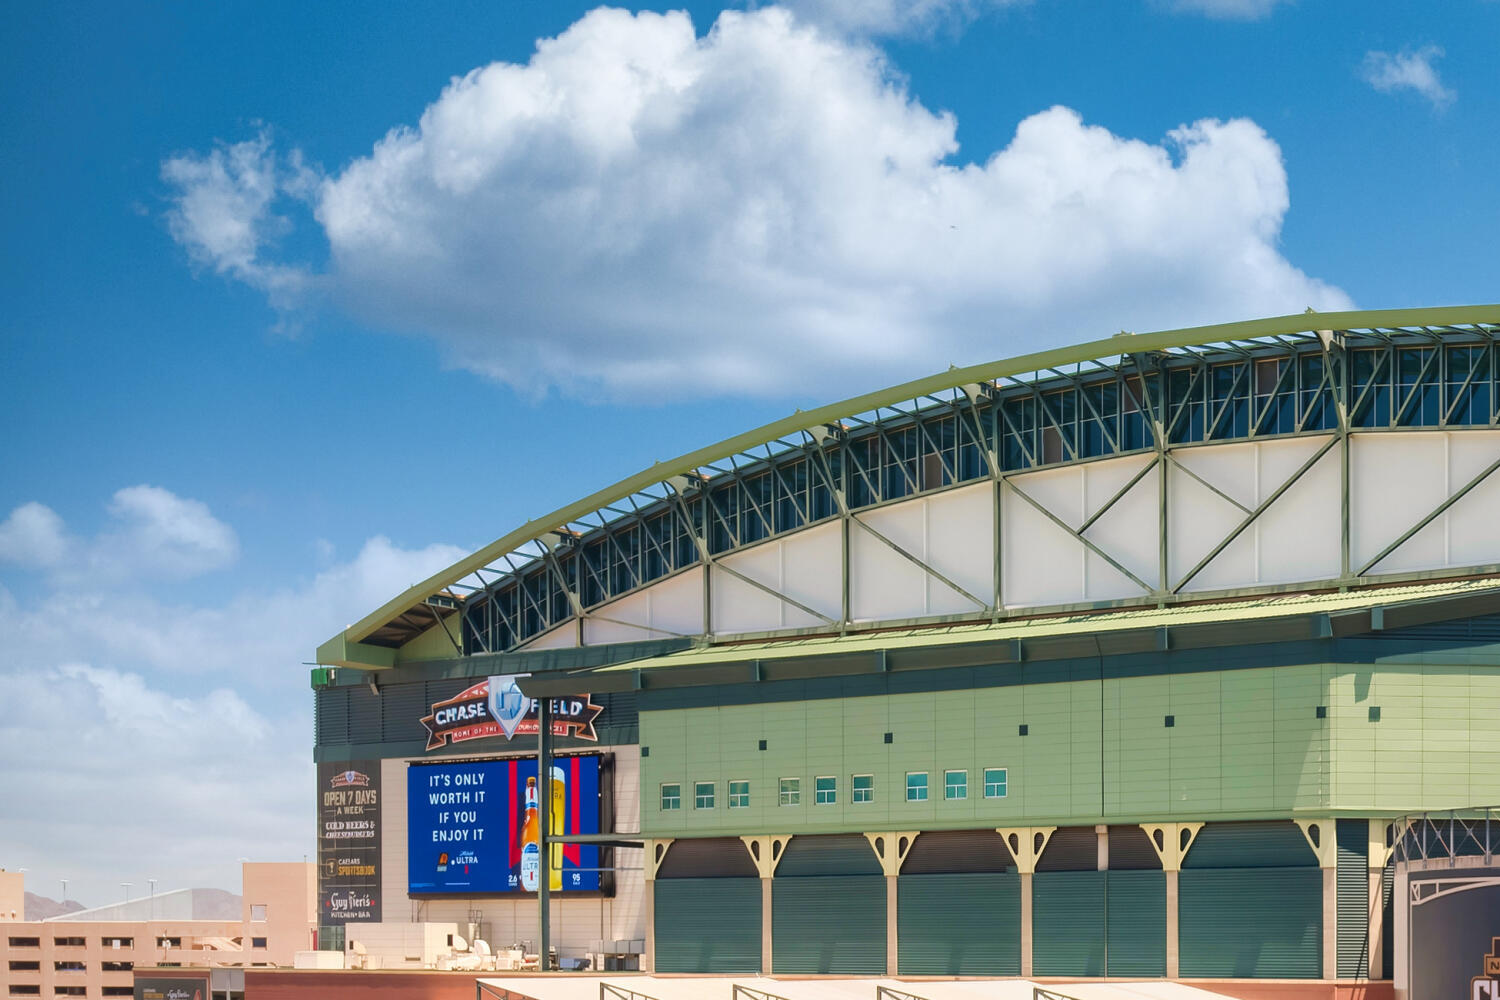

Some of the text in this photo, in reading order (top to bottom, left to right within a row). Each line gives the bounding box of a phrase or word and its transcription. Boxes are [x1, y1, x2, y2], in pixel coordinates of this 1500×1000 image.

[435, 699, 583, 725] CHASE FELD
[454, 730, 471, 739] HOME
[486, 726, 497, 734] THE
[430, 773, 485, 787] IT'S ONLY
[324, 790, 377, 806] OPEN 7 DAYS
[429, 791, 485, 805] WORTH IT
[337, 805, 364, 815] A WEEK
[439, 811, 477, 824] IF YOU
[432, 828, 484, 842] ENJOY IT
[456, 856, 478, 865] ULTRA
